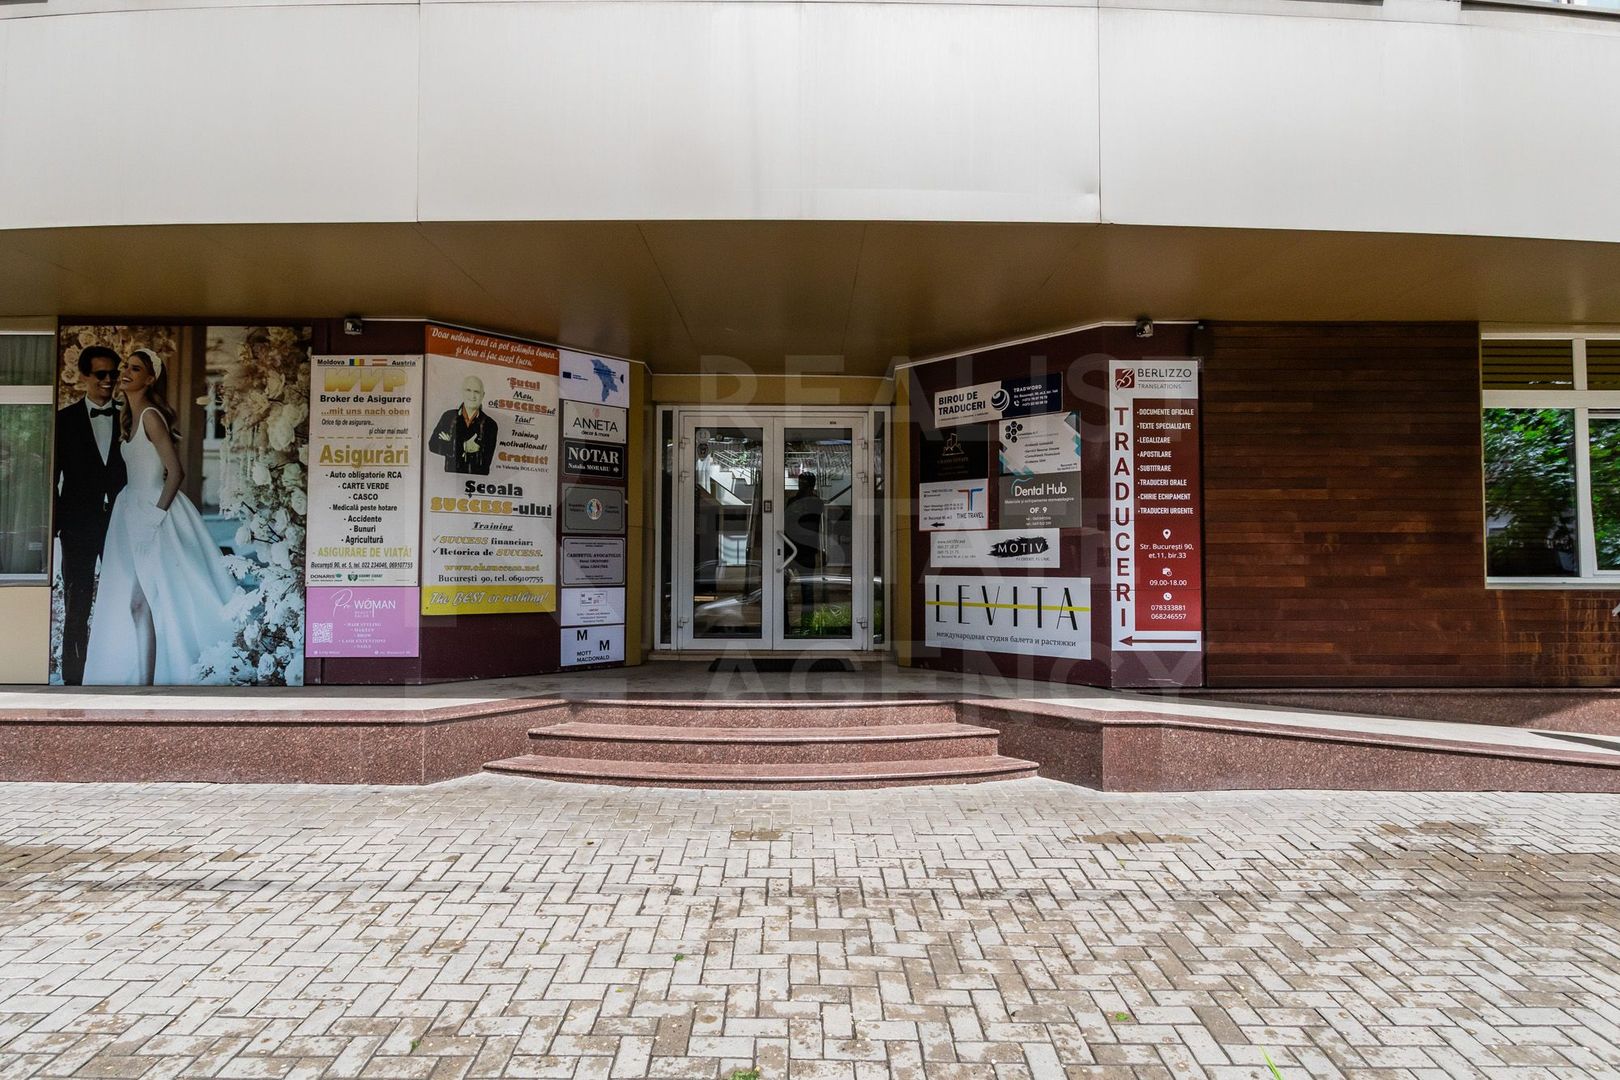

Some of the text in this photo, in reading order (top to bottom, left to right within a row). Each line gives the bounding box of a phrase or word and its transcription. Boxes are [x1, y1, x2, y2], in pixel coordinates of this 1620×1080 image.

[1138, 368, 1192, 378] BERLIZZO
[320, 395, 411, 404] Broker de Asigurare
[938, 391, 978, 405] BIROU DE
[364, 407, 385, 415] nach
[388, 407, 410, 415] oben
[939, 401, 986, 416] TRADUCERI
[1139, 408, 1194, 416] DOCUMENTE OFICIALE
[573, 417, 618, 432] ANNETA
[1139, 422, 1191, 430] TEXTE SPECIALIZATE
[511, 430, 539, 440] Training
[1139, 436, 1171, 444] LEGALIZARE
[320, 444, 408, 468] Asigurări
[568, 447, 619, 464] NOTAR
[1139, 450, 1172, 458] APOSTILARE
[330, 471, 402, 480] Auto obligatorie RCA
[1015, 481, 1067, 497] Dental Hub
[1114, 407, 1131, 627] TRADUCERI
[473, 522, 514, 531] Training
[318, 547, 366, 557] ASIGURARE
[370, 548, 380, 557] DE
[440, 548, 480, 556] Retorica
[997, 543, 1044, 553] MOTIV
[1152, 543, 1183, 551] București
[438, 575, 477, 583] București
[935, 584, 1078, 630] LEVITA
[577, 630, 588, 641] M
[936, 631, 985, 641] международная
[1010, 635, 1034, 644] балета
[1041, 638, 1077, 647] растяжки
[600, 640, 610, 651] M
